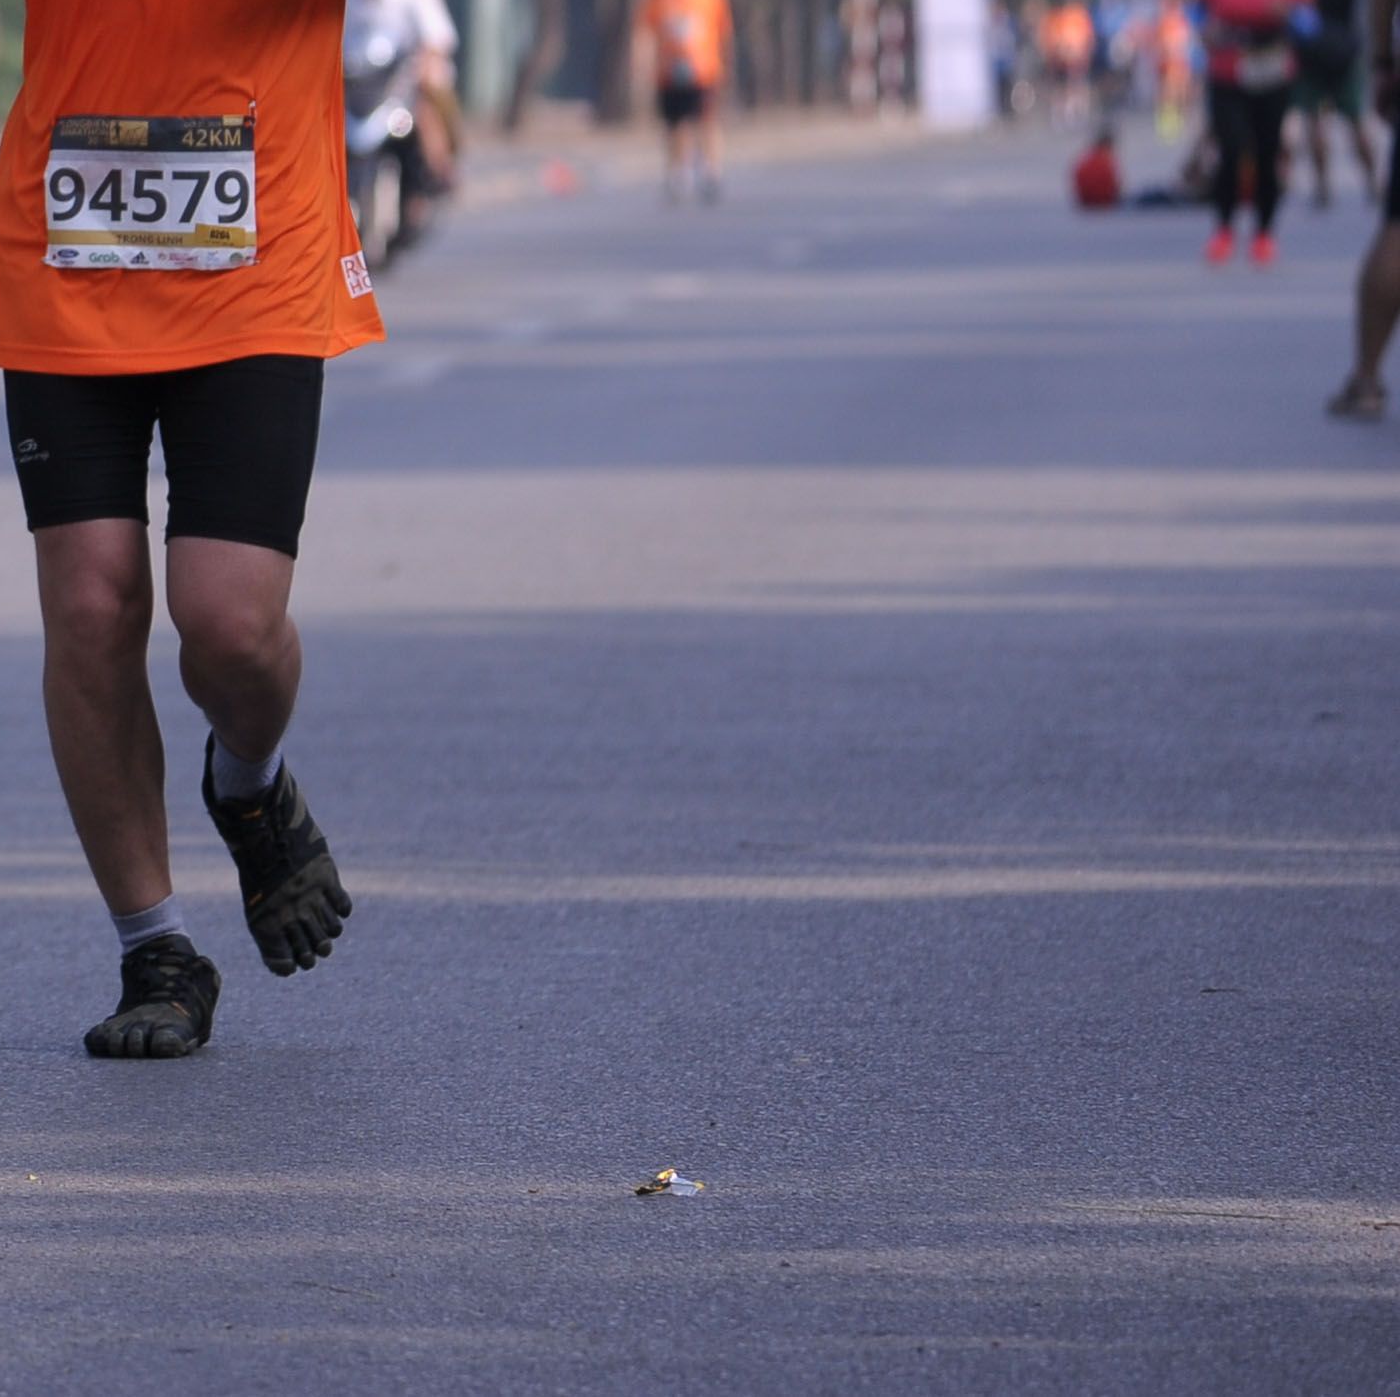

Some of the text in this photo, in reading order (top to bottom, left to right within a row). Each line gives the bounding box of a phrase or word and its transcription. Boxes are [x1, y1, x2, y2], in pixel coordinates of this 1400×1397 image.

[181, 128, 241, 147] 42KM
[50, 167, 250, 223] 94579
[88, 250, 120, 263] Grab
